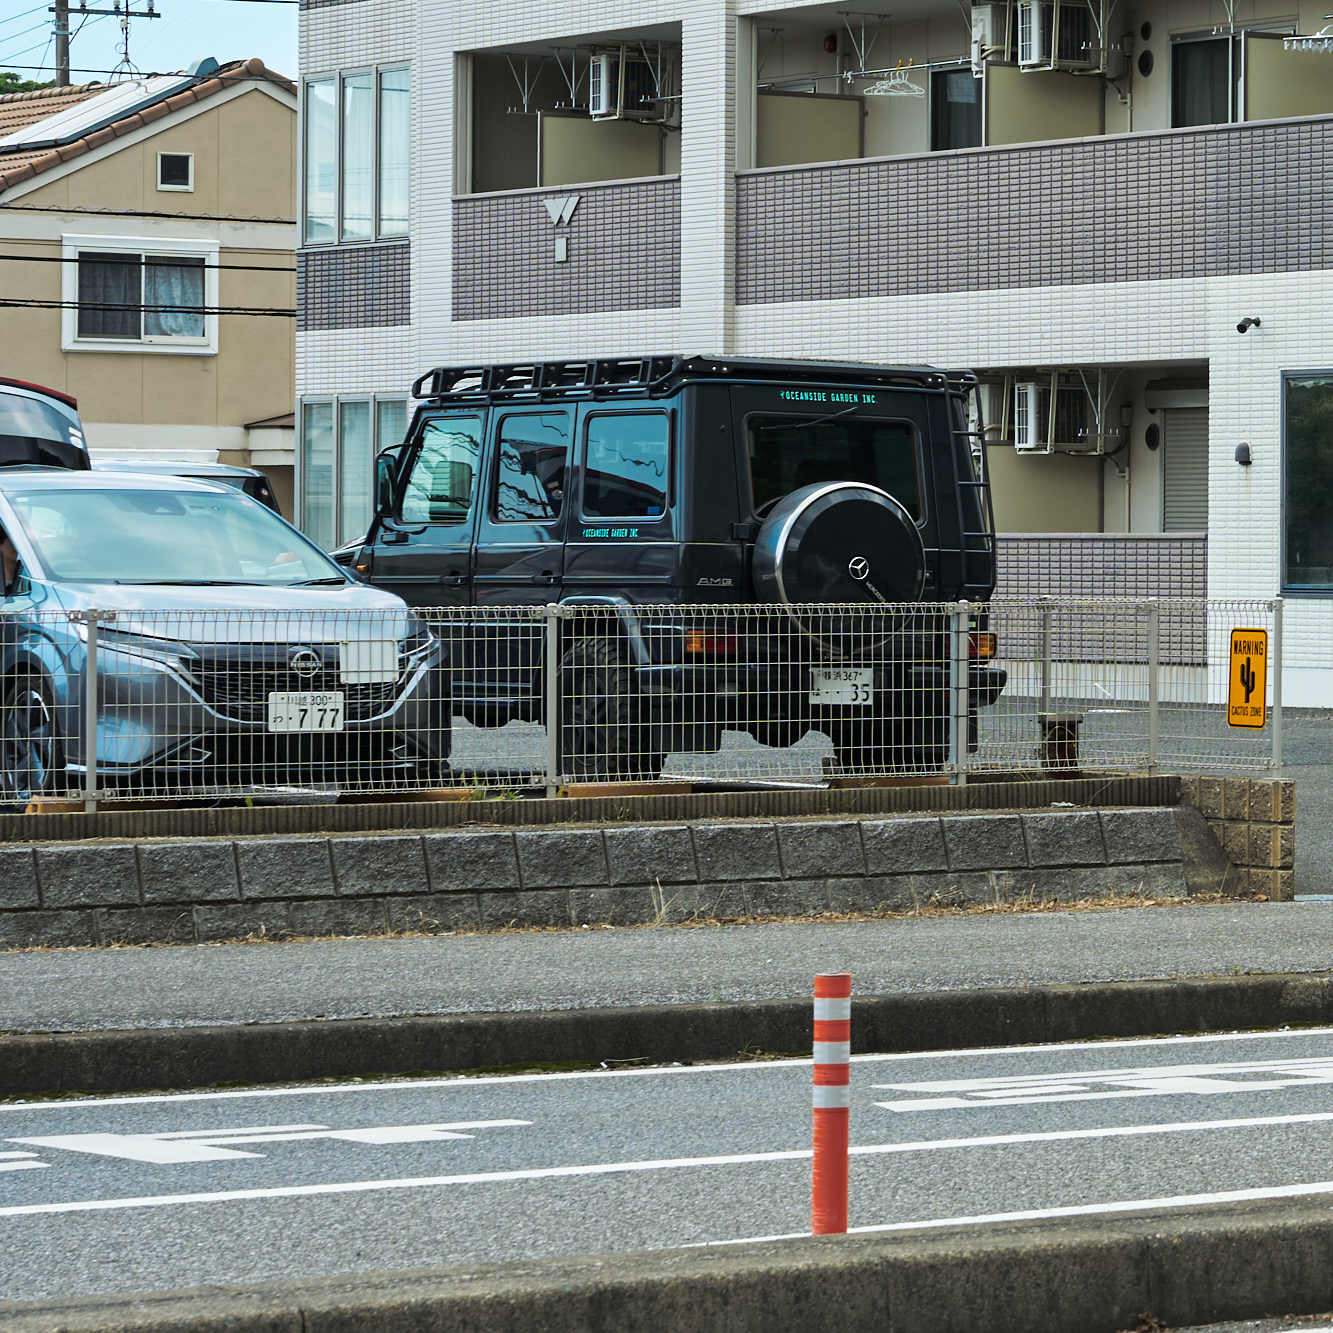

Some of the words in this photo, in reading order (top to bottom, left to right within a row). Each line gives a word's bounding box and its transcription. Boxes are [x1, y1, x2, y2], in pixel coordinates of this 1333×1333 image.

[785, 391, 827, 401] OCEANSIDE
[830, 393, 859, 403] GARDEN
[697, 577, 734, 586] AMG
[1233, 640, 1264, 656] WARNING
[309, 695, 328, 706] 300
[1232, 706, 1248, 716] CACTUS
[1250, 707, 1262, 716] ZONE
